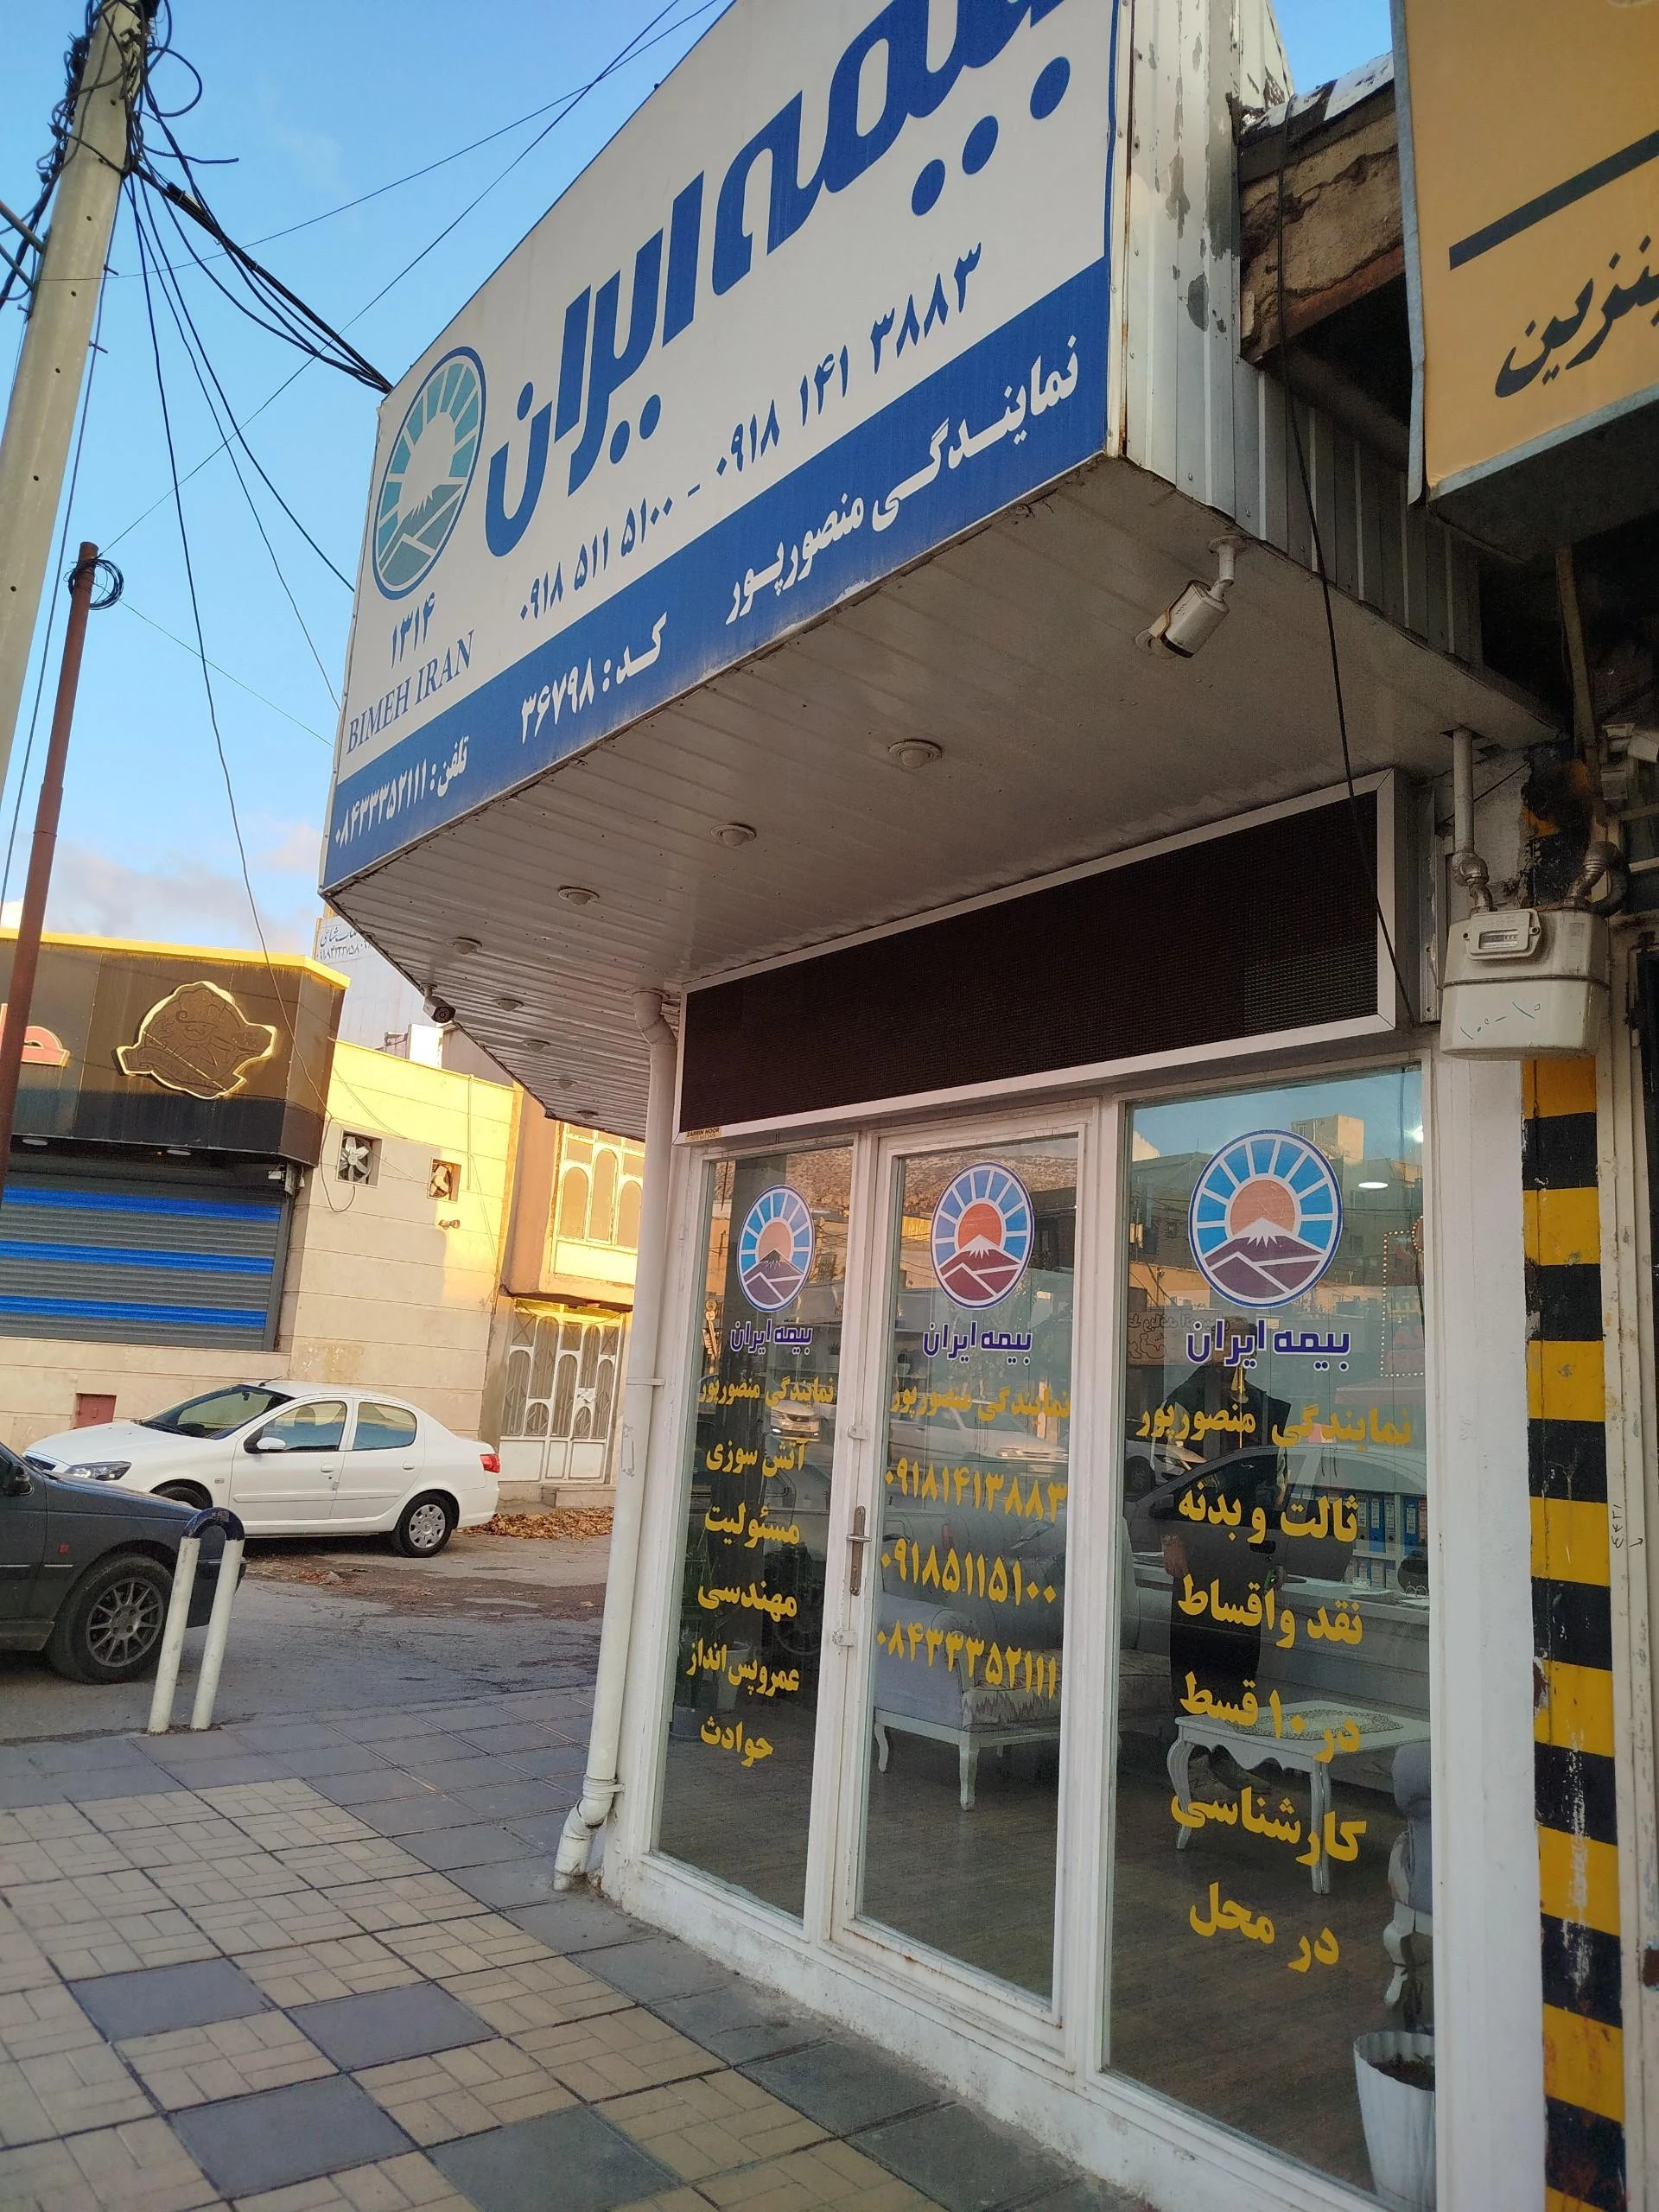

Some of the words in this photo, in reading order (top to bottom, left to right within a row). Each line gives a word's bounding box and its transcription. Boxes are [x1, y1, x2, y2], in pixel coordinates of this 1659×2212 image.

[486, 170, 704, 557] ایران
[520, 562, 563, 621] ۰۹۱۸
[574, 525, 610, 591] ۵۱۱
[620, 498, 674, 557] ۵۱۰۰
[715, 398, 780, 476] ۰۹۱۸
[799, 344, 849, 426] ۱۴۱
[870, 241, 982, 375] ۳۸۸۳
[871, 334, 1078, 532] نمایندگی
[725, 493, 864, 626] منصورپور
[391, 592, 435, 670] ۱۳۱۴
[346, 677, 411, 756] BIMEH
[415, 628, 474, 706] IRAN
[521, 657, 594, 746] ۳۶۷۹۸
[335, 758, 427, 850] ۰۸۴۳۳۳۵۲۱۱۱
[729, 1319, 772, 1355] ایران
[773, 1326, 813, 1355] بیمه
[922, 1320, 978, 1363] ایران
[980, 1331, 1033, 1365] بیمه
[1185, 1318, 1266, 1369] ایران
[1272, 1328, 1351, 1371] بیمه
[697, 1377, 760, 1406] منصورپور
[765, 1376, 834, 1408] نمایندگی
[890, 1385, 972, 1418] منصورپور
[977, 1385, 1071, 1426] نمایندگی
[1135, 1402, 1256, 1441] منصورپور
[1271, 1403, 1412, 1452] نمایندگی
[706, 1440, 759, 1474] سوزی
[885, 1457, 1068, 1523] ۰۹۱۸۱۴۱۳۸۸۳
[1178, 1481, 1243, 1541] بدنه
[704, 1502, 800, 1548] مسئولیت
[1247, 1506, 1267, 1544] و
[880, 1537, 1057, 1606] ۰۹۱۸۵۱۱۵۱۰۰
[697, 1580, 798, 1623] مهندسی
[1306, 1599, 1363, 1645] نقد
[877, 1618, 1056, 1700] ۰۸۴۳۳۳۵۲۱۱۱
[1179, 1670, 1259, 1726] قسط
[1268, 1688, 1306, 1740] ۱۰
[701, 1716, 774, 1767] حوادث
[1313, 1716, 1361, 1764] در
[1171, 1785, 1367, 1867] کارشناسی
[1189, 1881, 1276, 1944] محل
[1287, 1926, 1340, 1974] در
